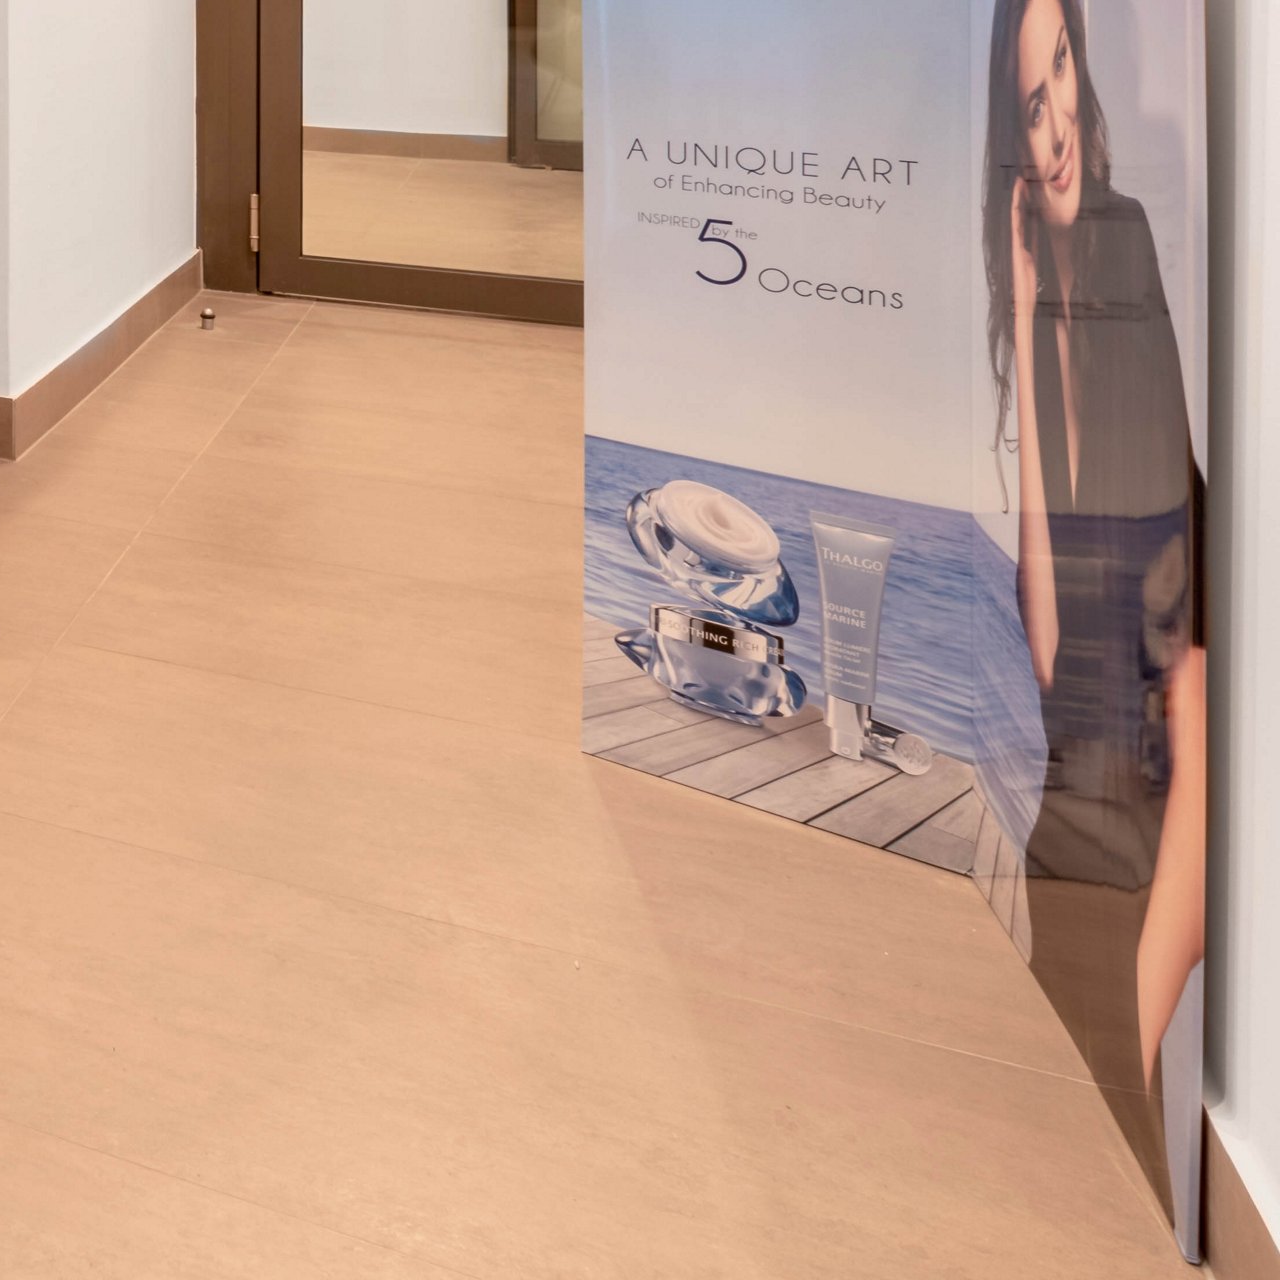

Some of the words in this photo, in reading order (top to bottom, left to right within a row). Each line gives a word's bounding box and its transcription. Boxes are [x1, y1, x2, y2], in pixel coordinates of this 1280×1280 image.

[626, 138, 648, 162] A
[667, 140, 819, 176] UNIQUE
[841, 156, 919, 186] ART
[653, 174, 675, 190] of
[681, 174, 794, 205] Enhancing
[803, 186, 887, 215] Beauty
[637, 211, 701, 230] INSPIRED
[711, 224, 730, 239] by
[735, 227, 758, 241] the
[696, 218, 748, 286] 5
[758, 267, 904, 310] Oceans
[821, 546, 883, 572] THALGO
